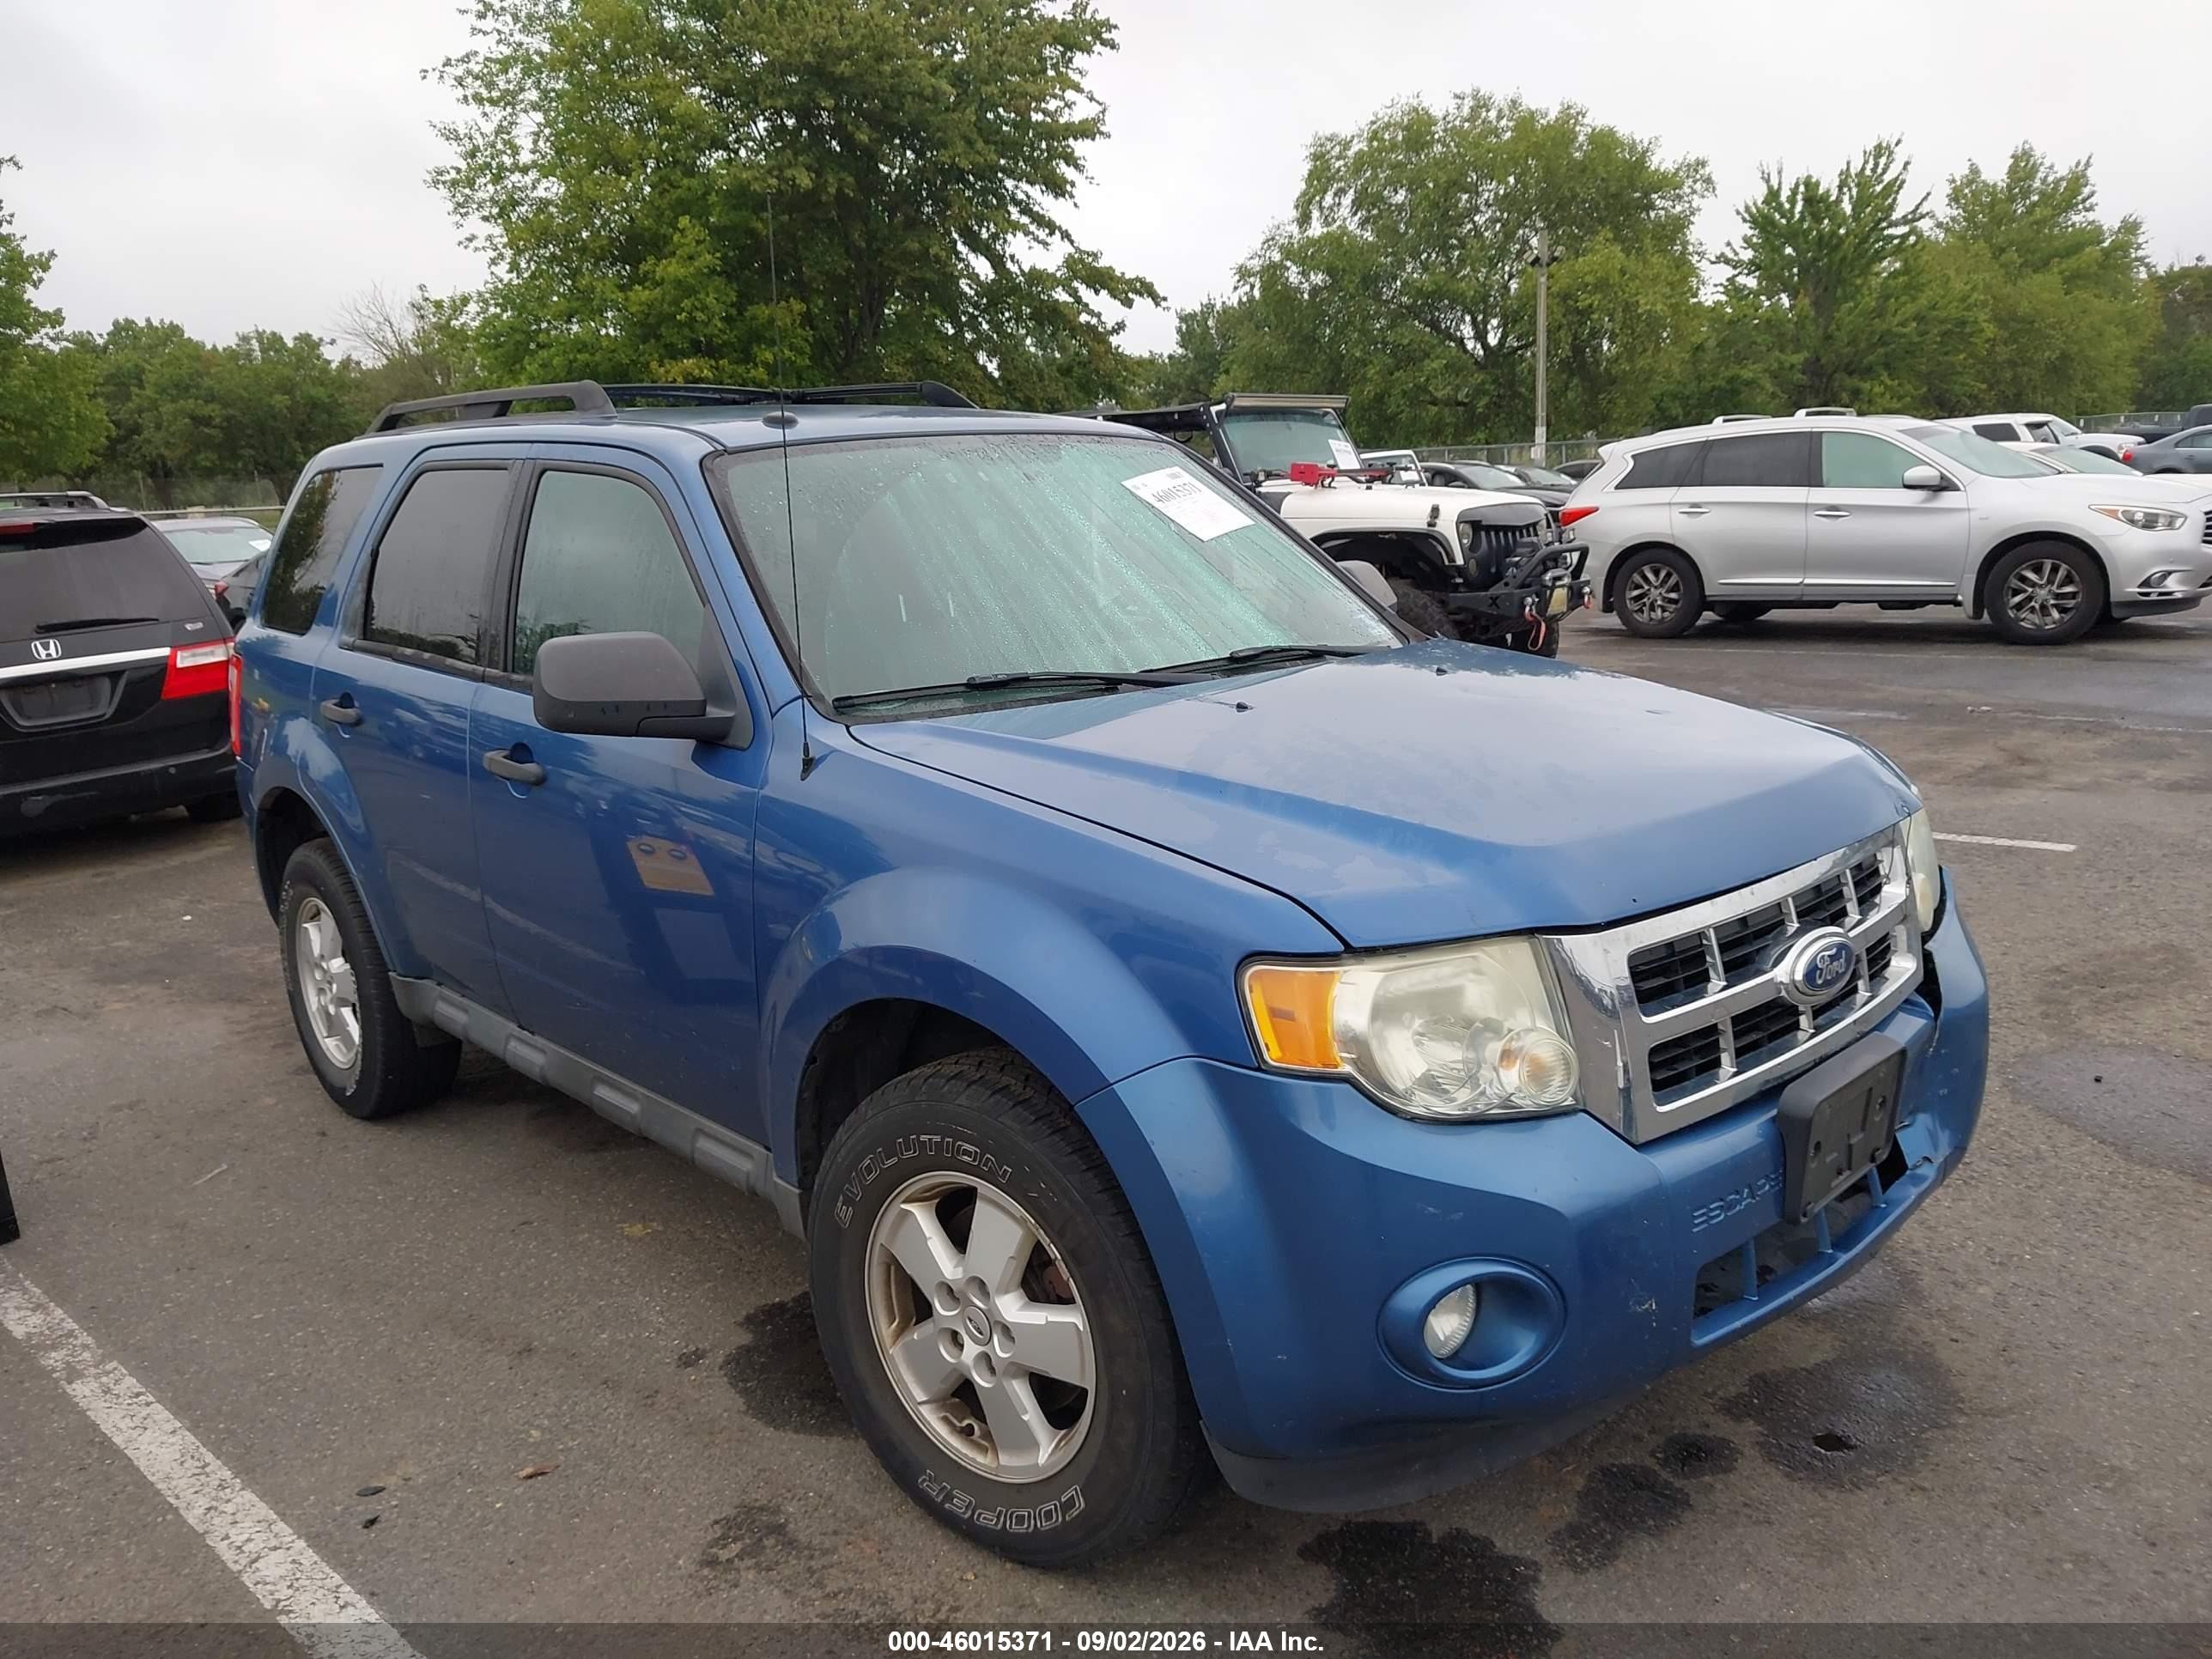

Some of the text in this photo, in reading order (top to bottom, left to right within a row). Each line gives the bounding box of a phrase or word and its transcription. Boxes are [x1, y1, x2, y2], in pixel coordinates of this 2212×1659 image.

[1152, 481, 1202, 505] 46015371
[1815, 947, 1846, 985] Ford
[833, 1133, 1013, 1230] EVOLUTION
[917, 1469, 1086, 1533] COOPER
